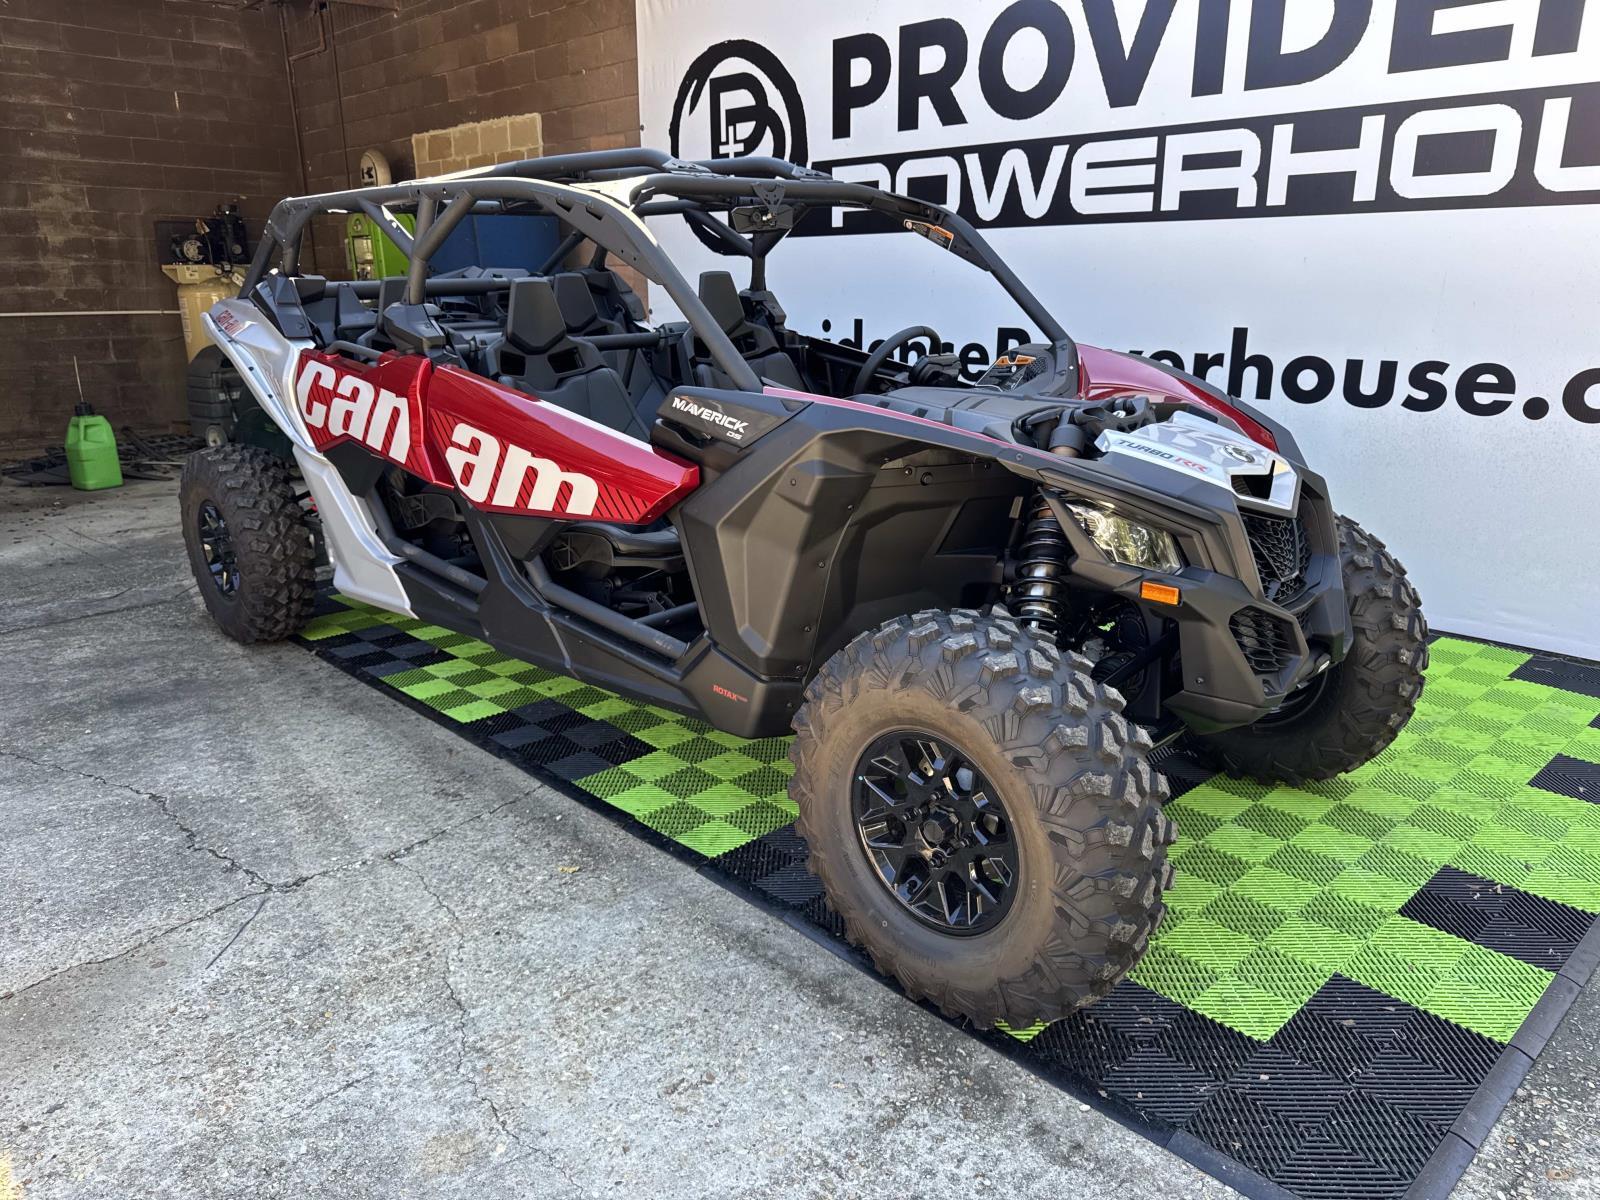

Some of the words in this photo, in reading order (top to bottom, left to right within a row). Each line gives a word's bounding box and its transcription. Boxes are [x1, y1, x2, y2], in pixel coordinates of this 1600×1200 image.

[832, 0, 1586, 139] PROVIDE
[672, 397, 749, 433] MAVERICK
[296, 360, 411, 464] can
[445, 422, 599, 516] am
[726, 430, 743, 440] DS
[1119, 439, 1173, 460] TURBO
[1175, 458, 1208, 472] RR
[713, 684, 737, 701] ROTAX
